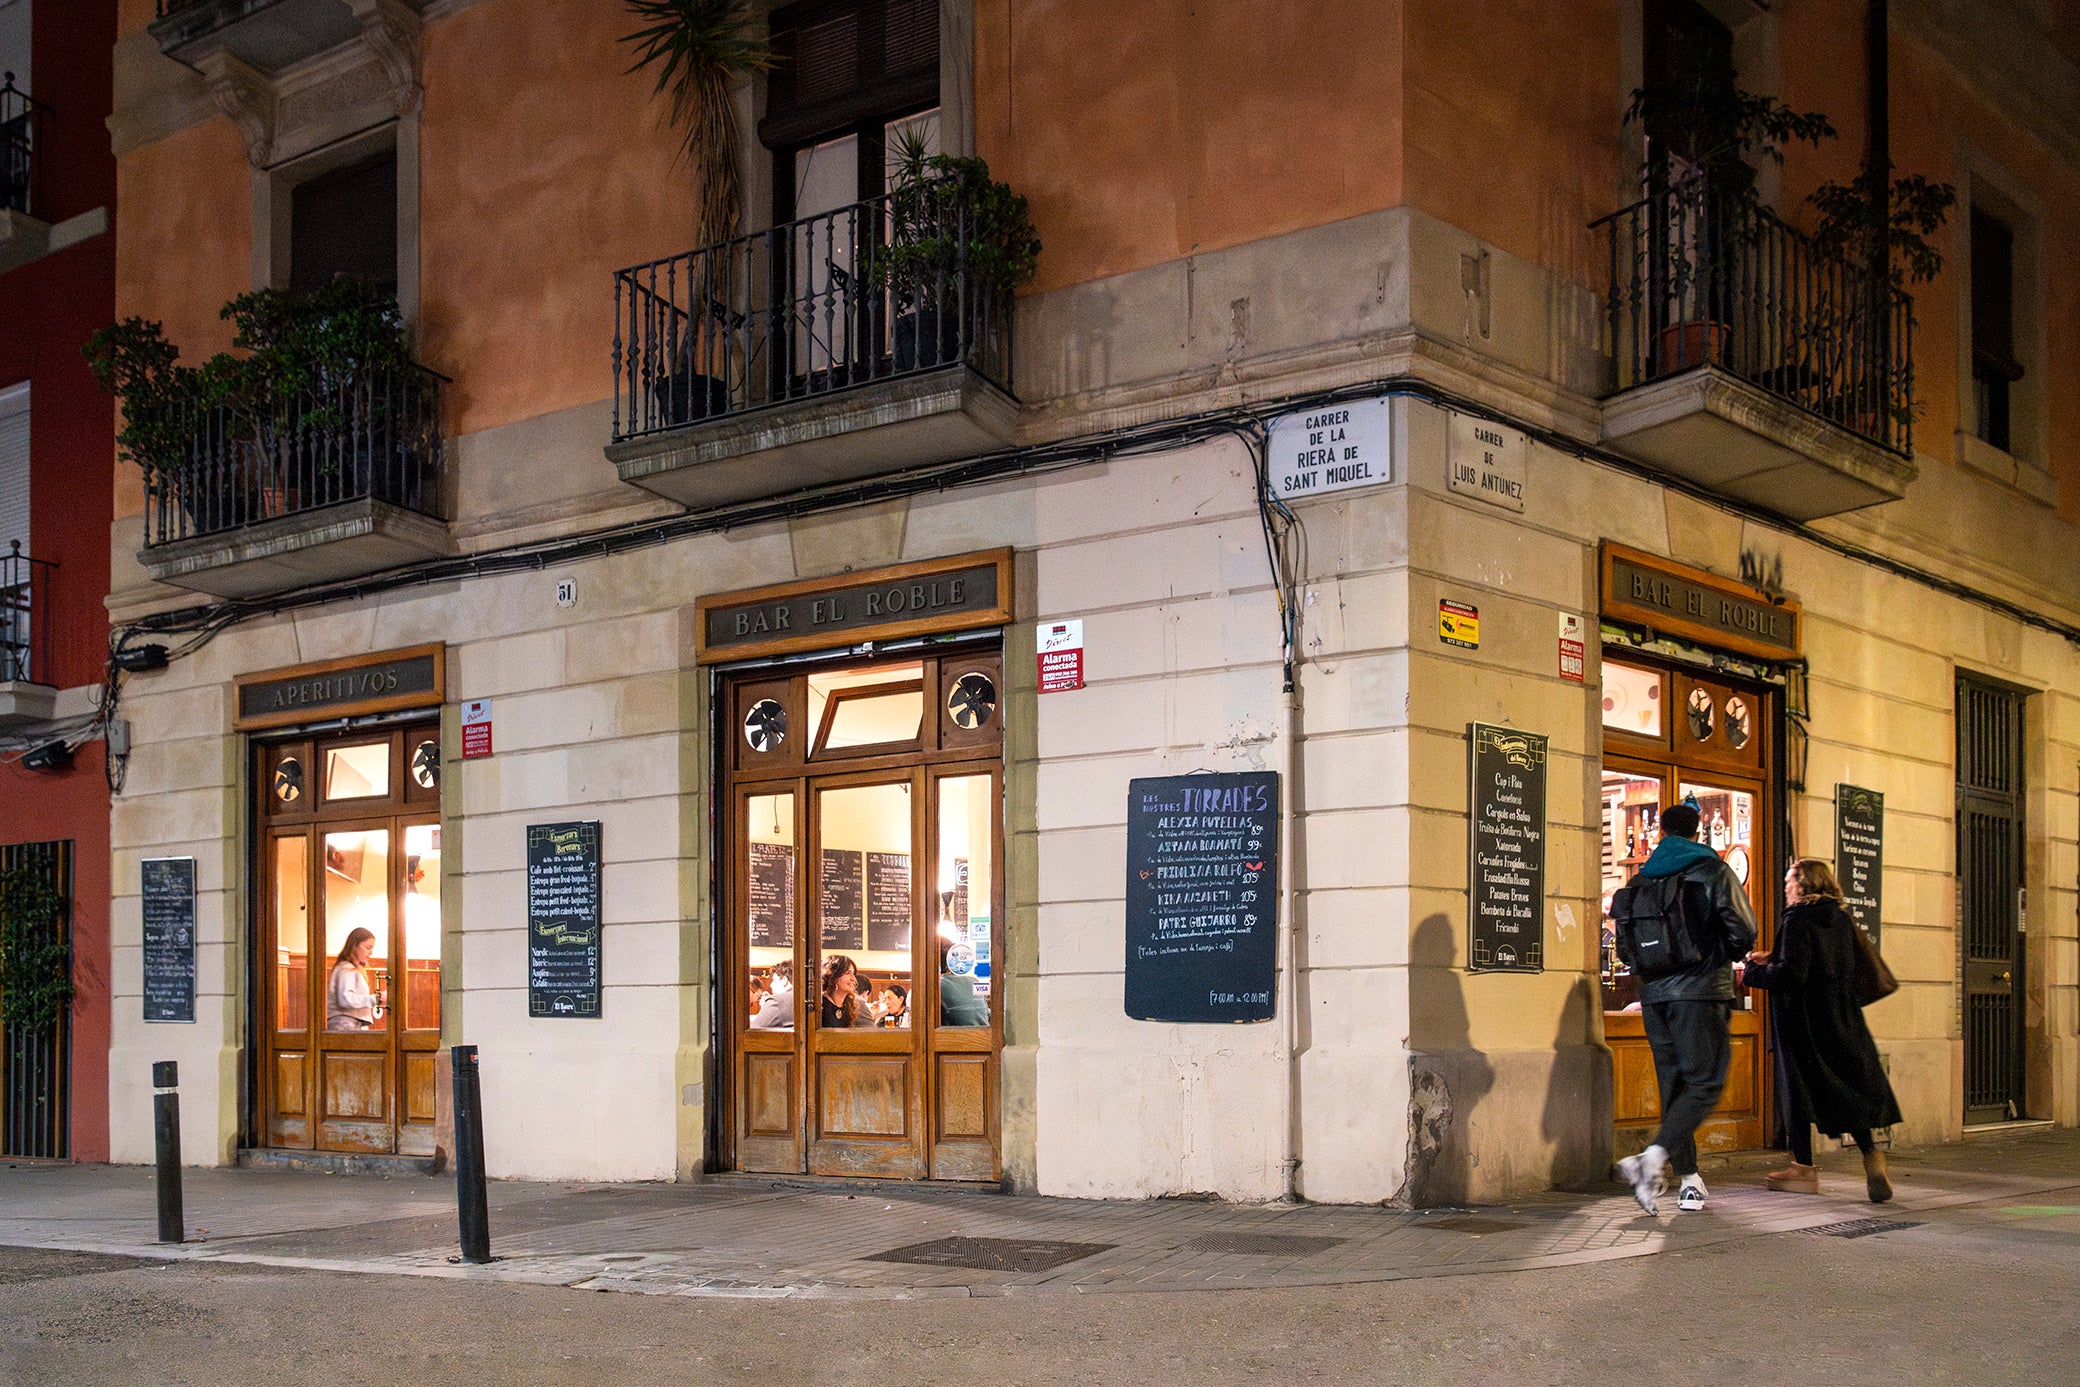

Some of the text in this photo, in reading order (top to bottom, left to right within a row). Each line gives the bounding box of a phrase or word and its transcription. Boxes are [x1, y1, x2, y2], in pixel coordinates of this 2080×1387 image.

[1306, 410, 1350, 430] CARRER
[1309, 427, 1346, 446] DE LA
[1474, 427, 1504, 448] CARRER
[1297, 446, 1359, 469] RIERA DE
[1484, 451, 1494, 466] DE
[1284, 462, 1373, 492] SANT MIQUEL
[1454, 462, 1476, 485] LUIS
[558, 584, 571, 601] 51
[735, 578, 967, 636] BAR EL ROBLE
[1631, 573, 1778, 638] BAR EL ROBLE
[1561, 640, 1582, 653] Alarma
[1043, 653, 1077, 665] Alarma
[1043, 662, 1078, 672] conectada
[272, 668, 398, 708] APERITIVOS
[466, 726, 488, 735] Alarma
[1495, 772, 1523, 789] Cap i Pota
[1143, 784, 1268, 813] NOSTRES TORRADES
[1143, 795, 1159, 803] LES
[1486, 803, 1531, 823] Cargols en Salsa
[1157, 816, 1253, 829] ALEXIA PUTELLAS
[1478, 820, 1540, 843] Truita de Botifarra Negra
[543, 866, 553, 874] amb
[1157, 864, 1212, 880] FRIDOLINA
[1504, 855, 1525, 872] Fregides
[1484, 869, 1530, 886] Ensaladilla Russa
[1157, 892, 1182, 906] KIKA
[1489, 886, 1510, 901] Patates
[1480, 901, 1505, 916] Bombeta
[1506, 906, 1511, 917] de
[1159, 916, 1187, 930] PATRI
[1189, 914, 1237, 928] GUIJARRO
[1495, 920, 1520, 934] Fricandó
